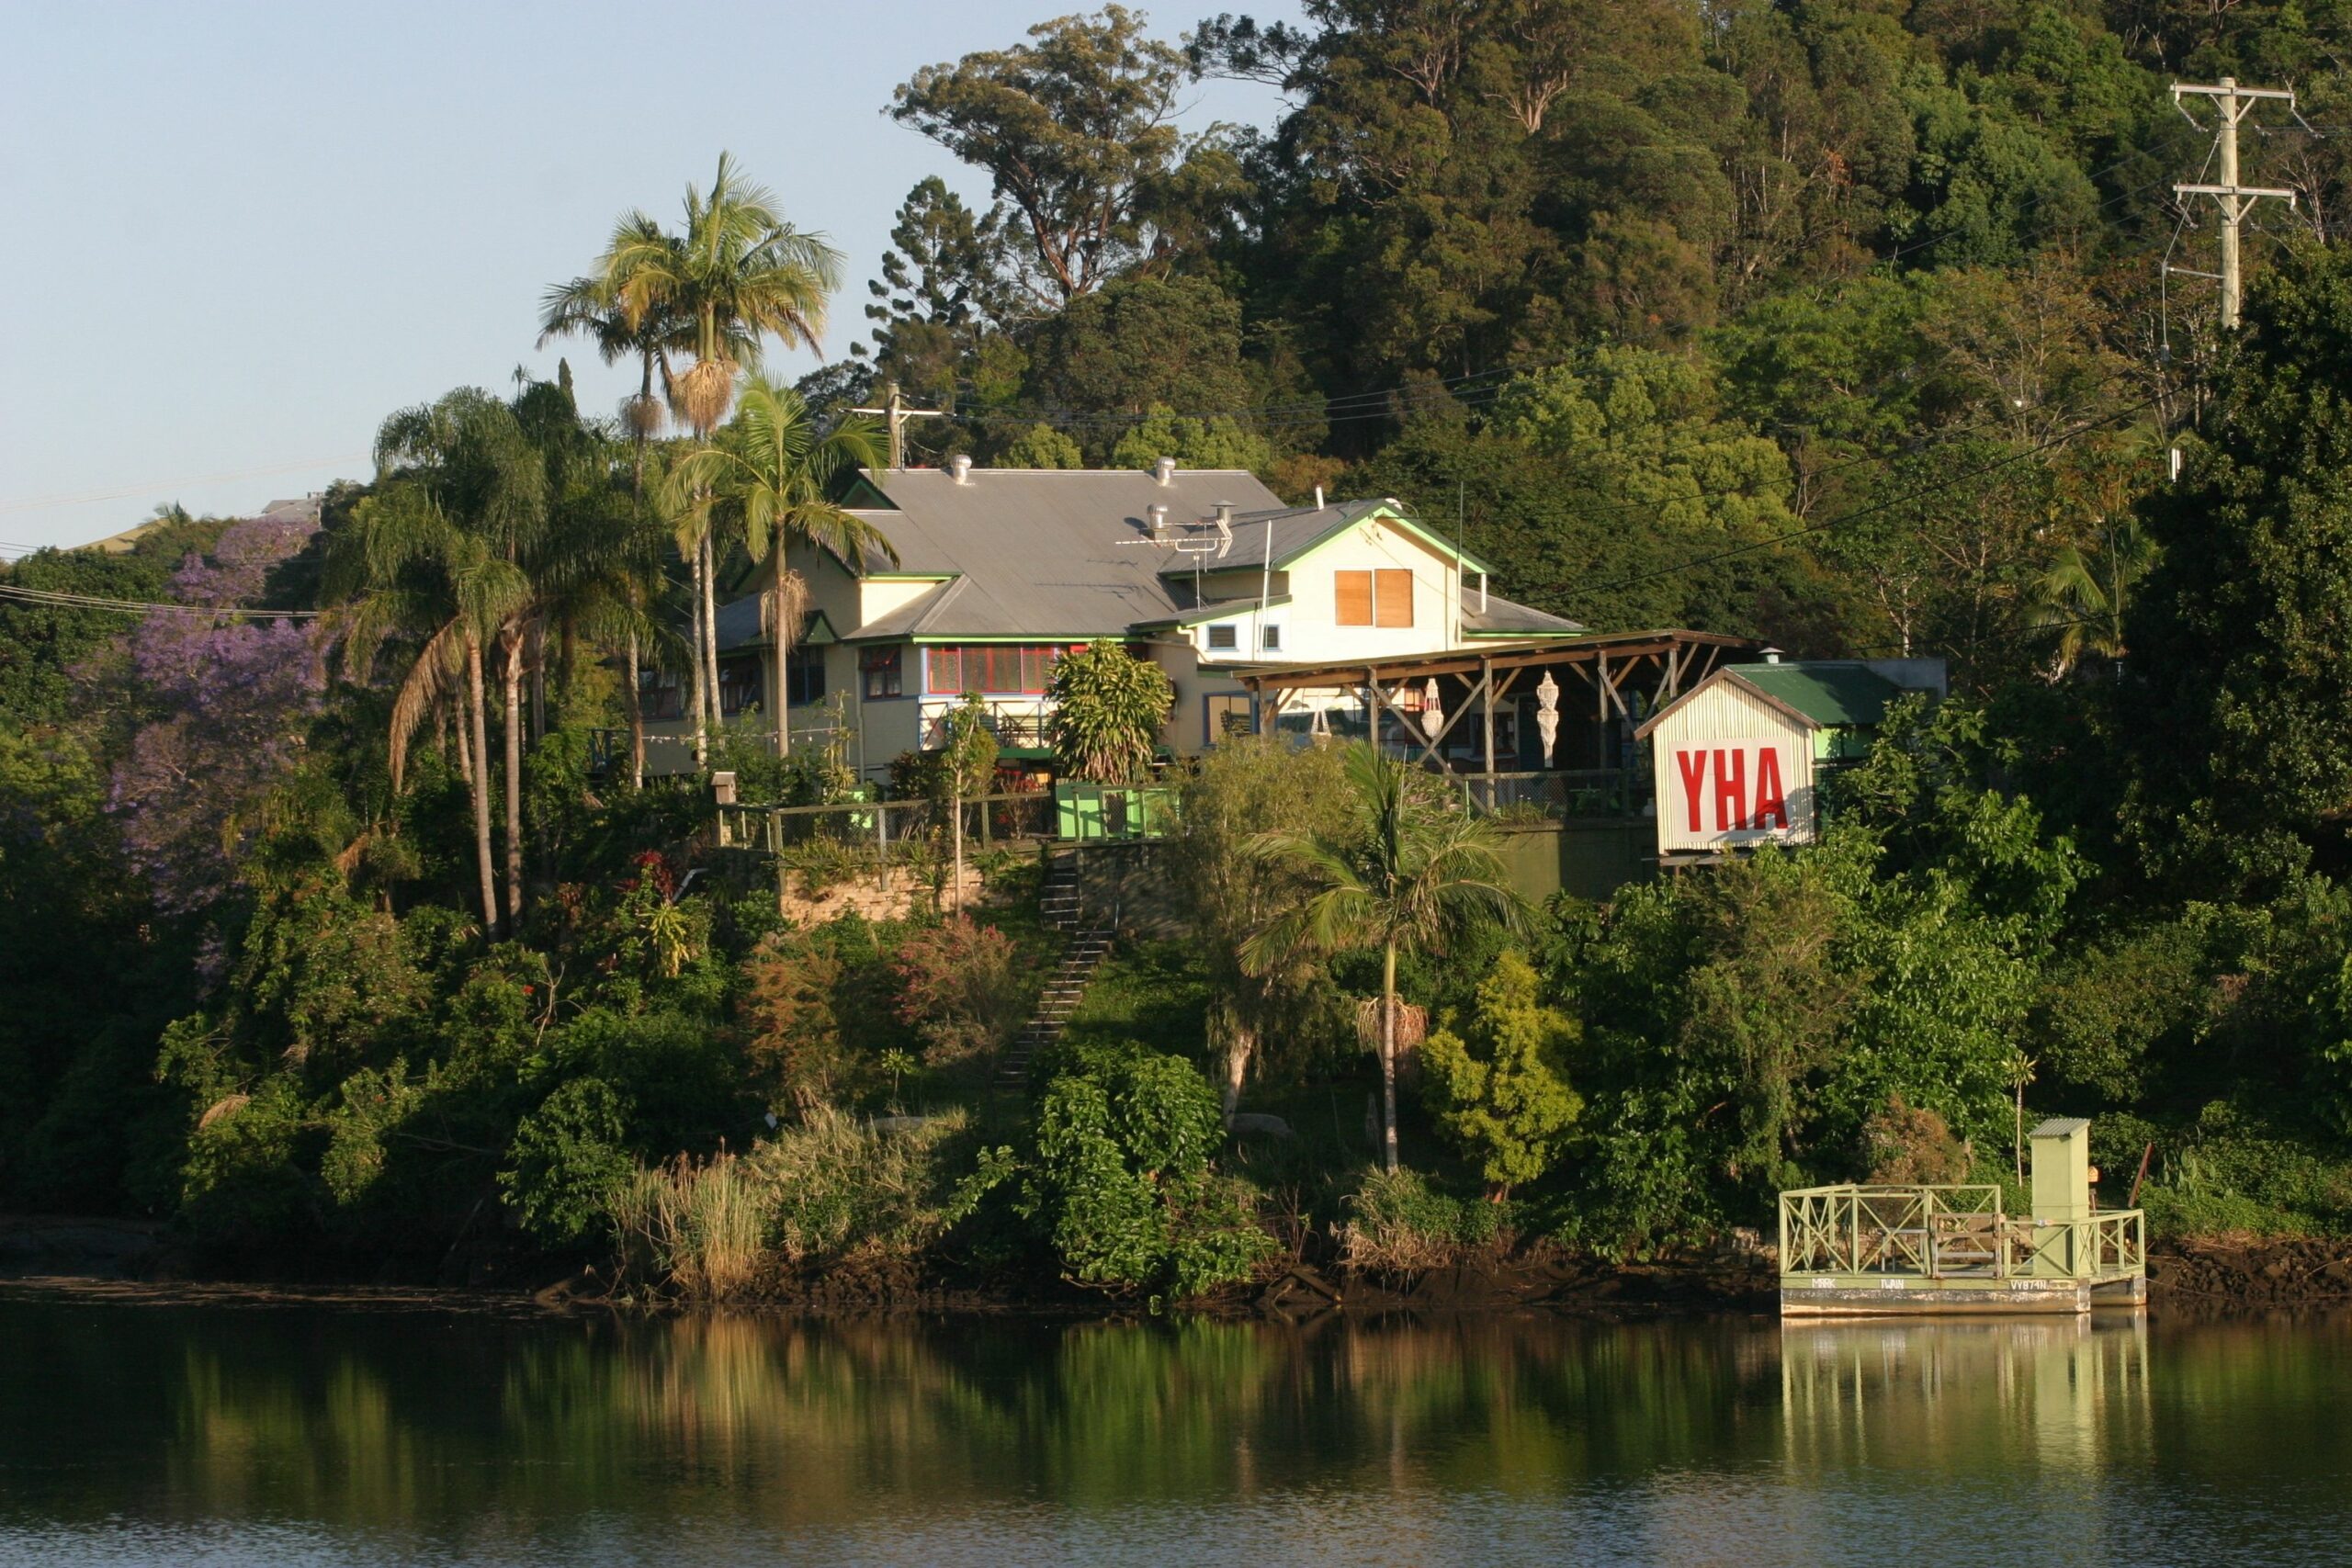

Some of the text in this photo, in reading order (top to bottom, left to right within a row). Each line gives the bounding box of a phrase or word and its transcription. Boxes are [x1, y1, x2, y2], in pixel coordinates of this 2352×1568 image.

[1676, 748, 1788, 832] YHA
[1812, 1278, 1904, 1289] MARK TWAIN
